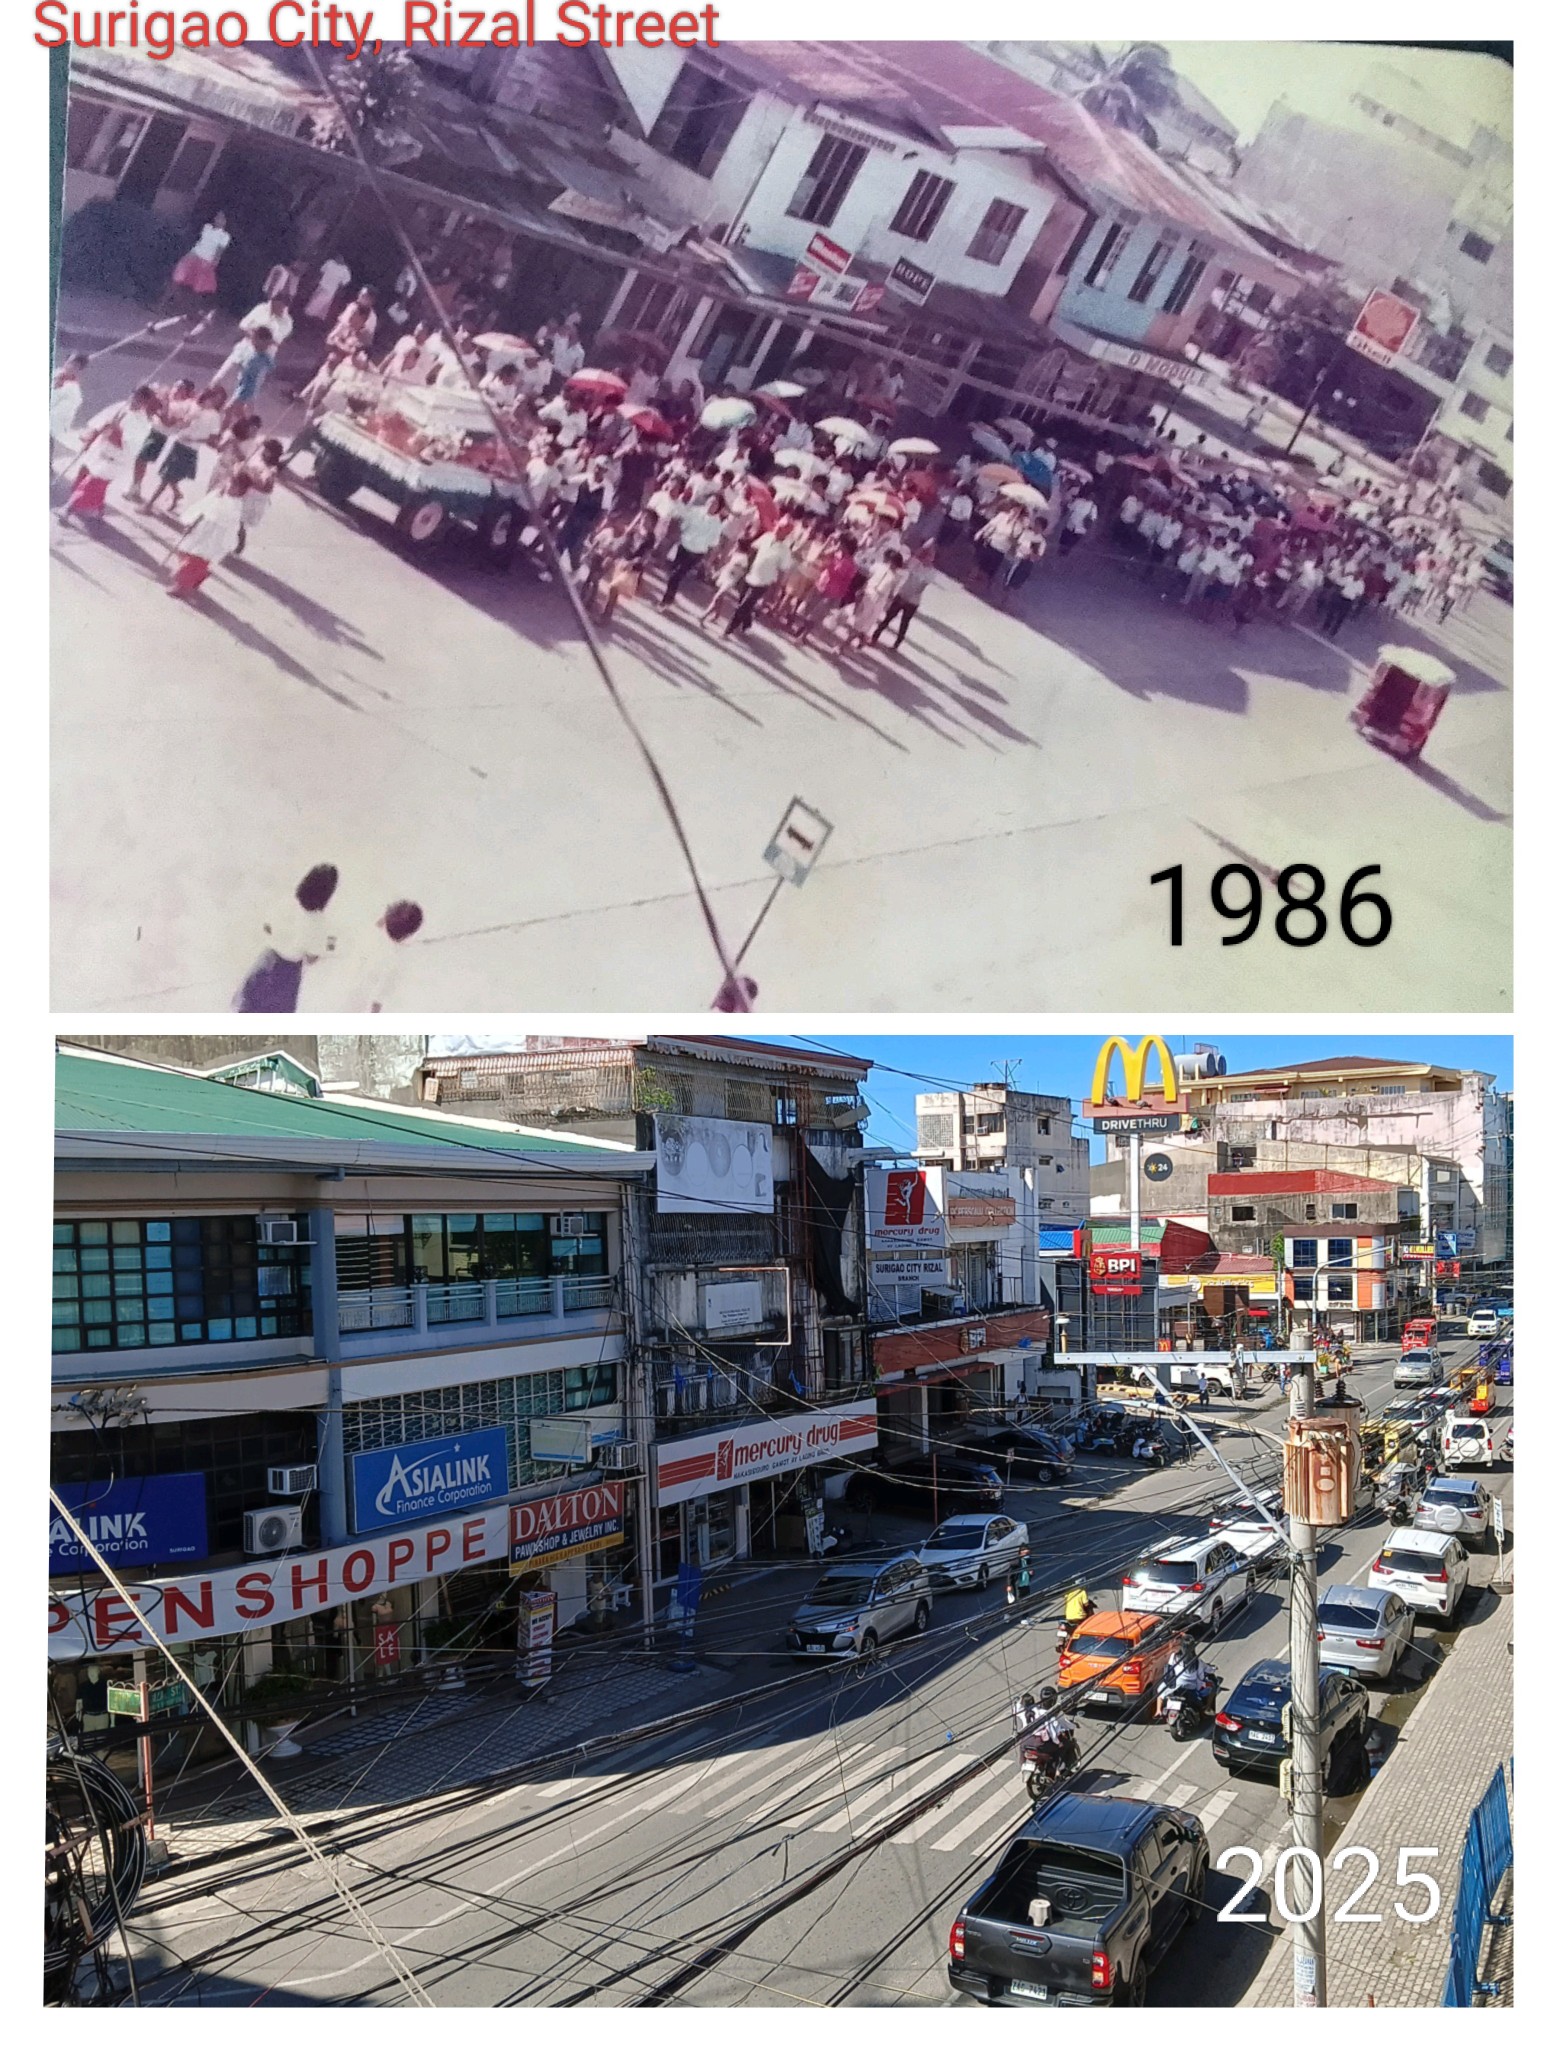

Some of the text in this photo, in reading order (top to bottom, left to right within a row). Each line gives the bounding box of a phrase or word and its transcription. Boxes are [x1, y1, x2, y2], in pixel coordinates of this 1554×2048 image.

[1157, 1163, 1168, 1172] 24
[874, 1226, 940, 1237] mercury drug
[876, 1261, 943, 1273] SURIGAO CITY RIZAL
[1107, 1258, 1136, 1273] BPI
[734, 1423, 839, 1467] mercury drug
[376, 1453, 491, 1510] ASIALINK
[396, 1482, 493, 1514] Finance Corporation
[514, 1484, 620, 1540] DALTON
[561, 1532, 568, 1546] &
[570, 1522, 604, 1544] JEWELRY
[604, 1518, 620, 1534] INC.
[58, 1538, 148, 1558] Corporaion
